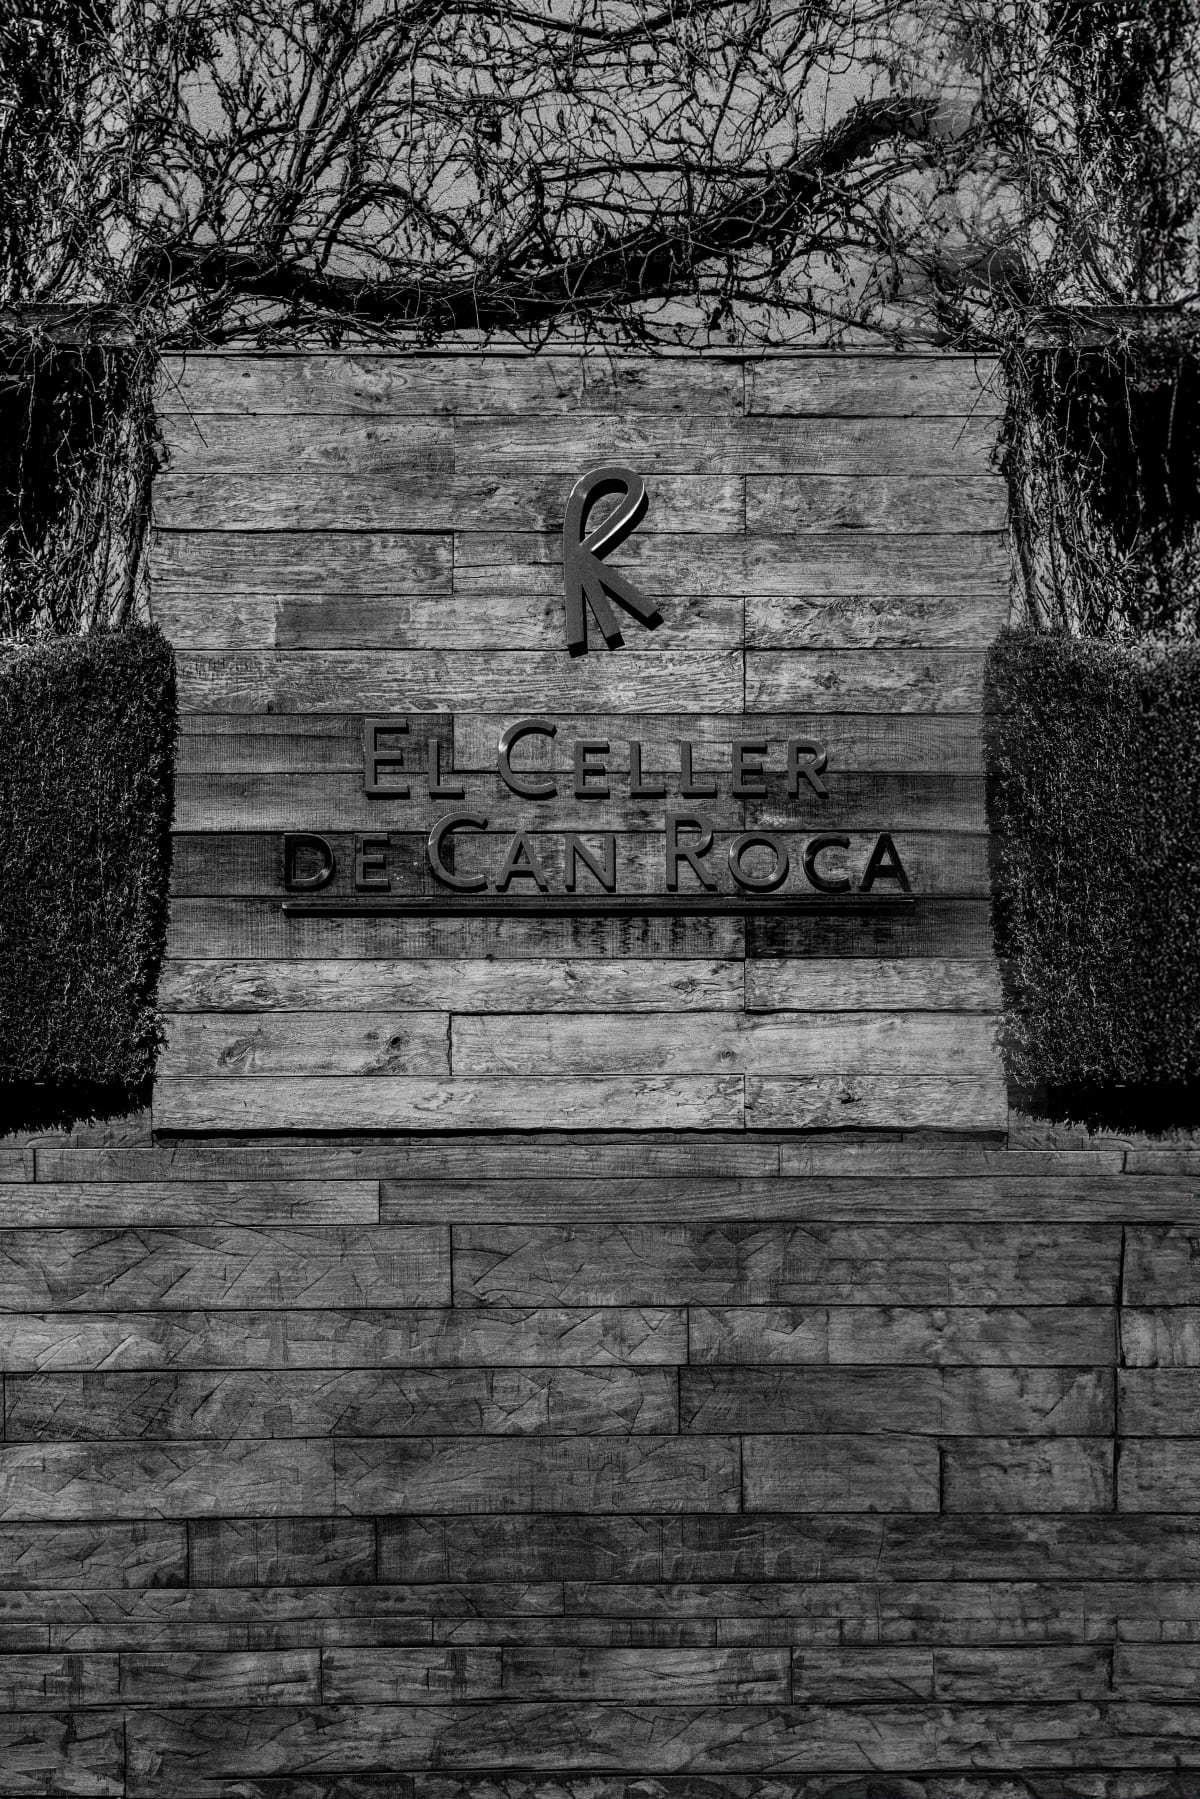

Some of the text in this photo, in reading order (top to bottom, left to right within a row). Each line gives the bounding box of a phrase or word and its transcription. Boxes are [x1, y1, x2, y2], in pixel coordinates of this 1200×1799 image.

[363, 718, 828, 799] EL CELLER
[283, 810, 912, 893] DE CAN ROCA
